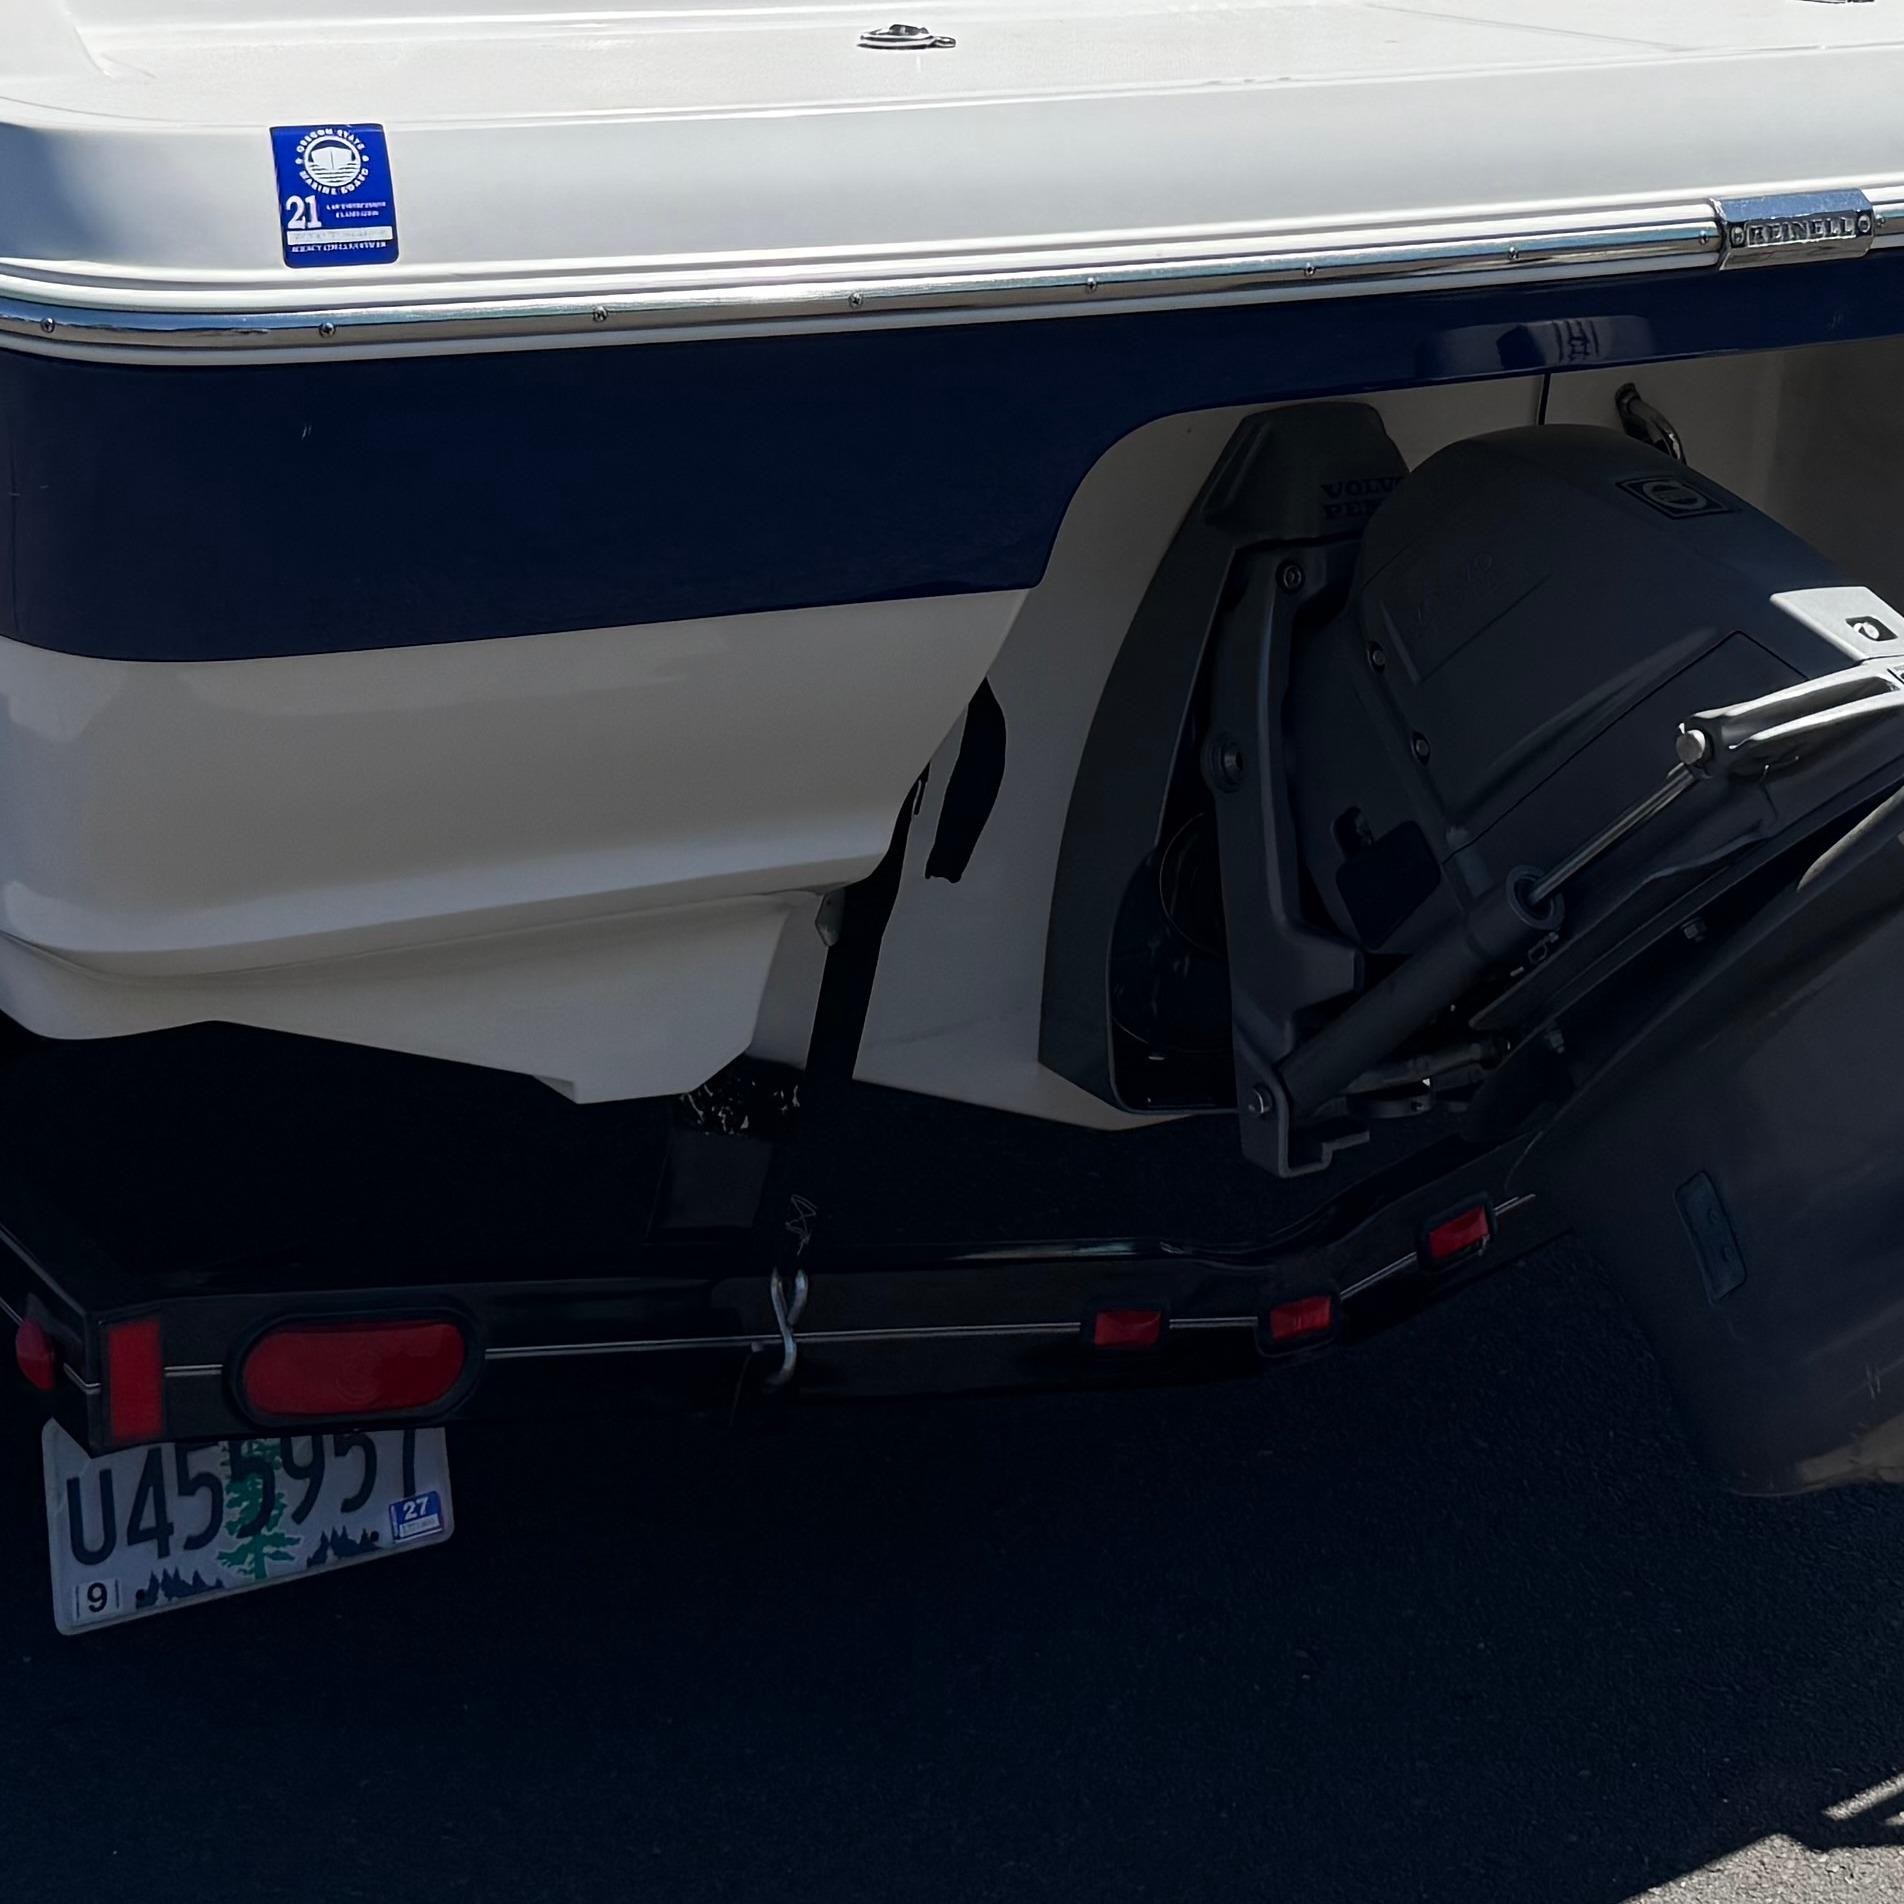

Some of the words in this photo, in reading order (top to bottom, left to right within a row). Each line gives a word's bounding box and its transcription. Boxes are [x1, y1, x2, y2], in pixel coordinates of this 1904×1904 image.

[286, 195, 322, 229] 21
[1748, 216, 1855, 246] REINELL
[1320, 478, 1400, 499] VOLV
[403, 1496, 430, 1520] 27
[86, 1583, 108, 1613] 9
